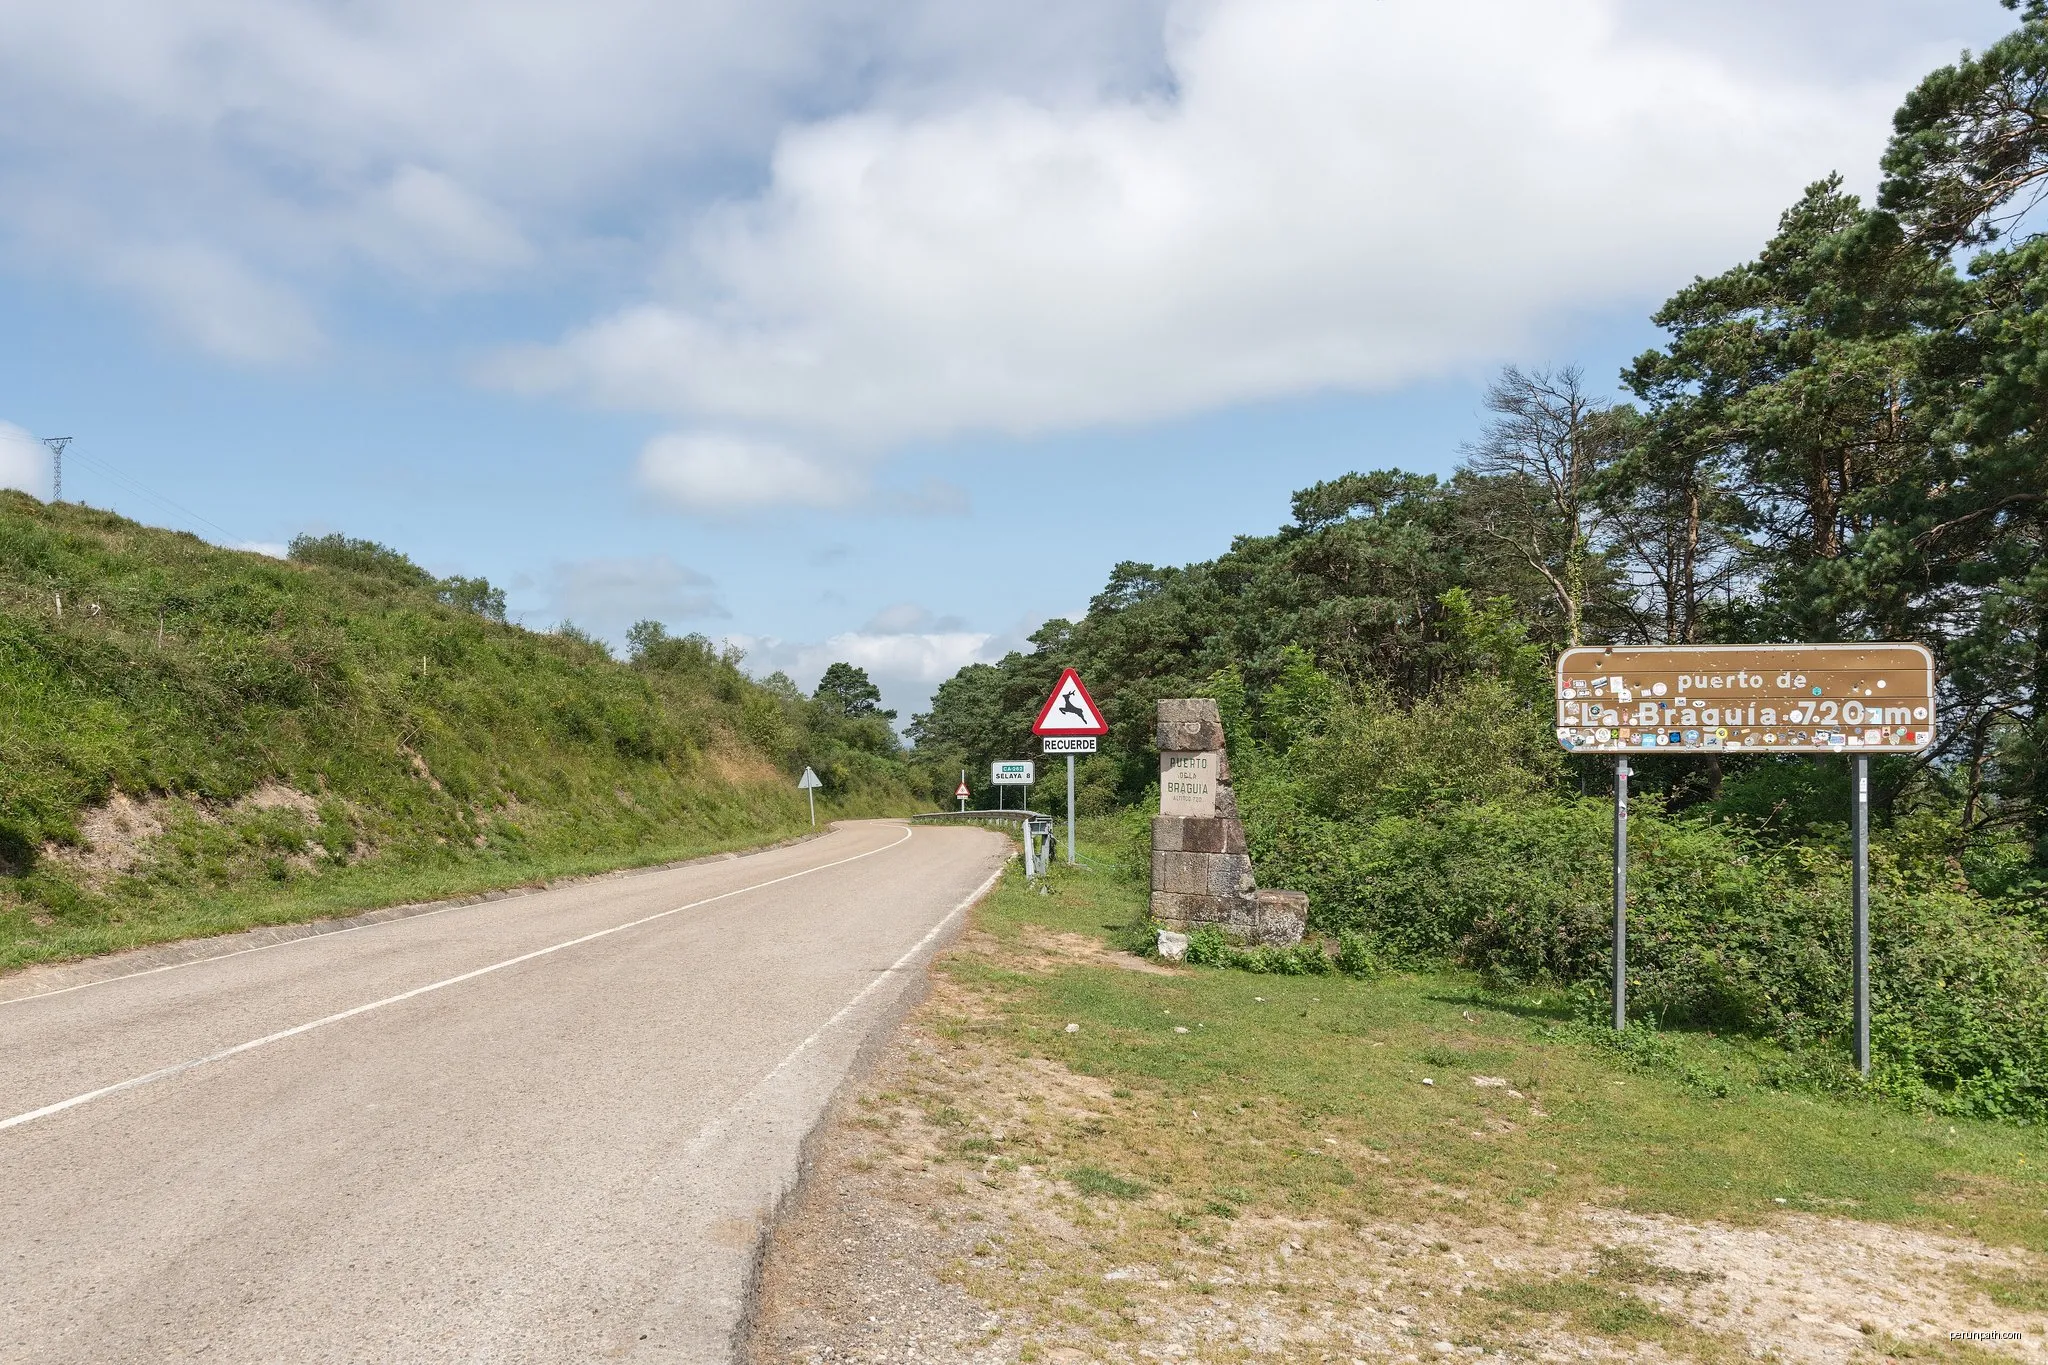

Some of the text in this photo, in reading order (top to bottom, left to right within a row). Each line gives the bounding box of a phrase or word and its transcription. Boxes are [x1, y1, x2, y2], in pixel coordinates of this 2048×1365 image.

[1678, 671, 1807, 693] puerto de
[1581, 700, 1912, 733] La Braguía 720 m
[1044, 739, 1096, 750] RECUERDE
[1170, 757, 1207, 769] PUERTO
